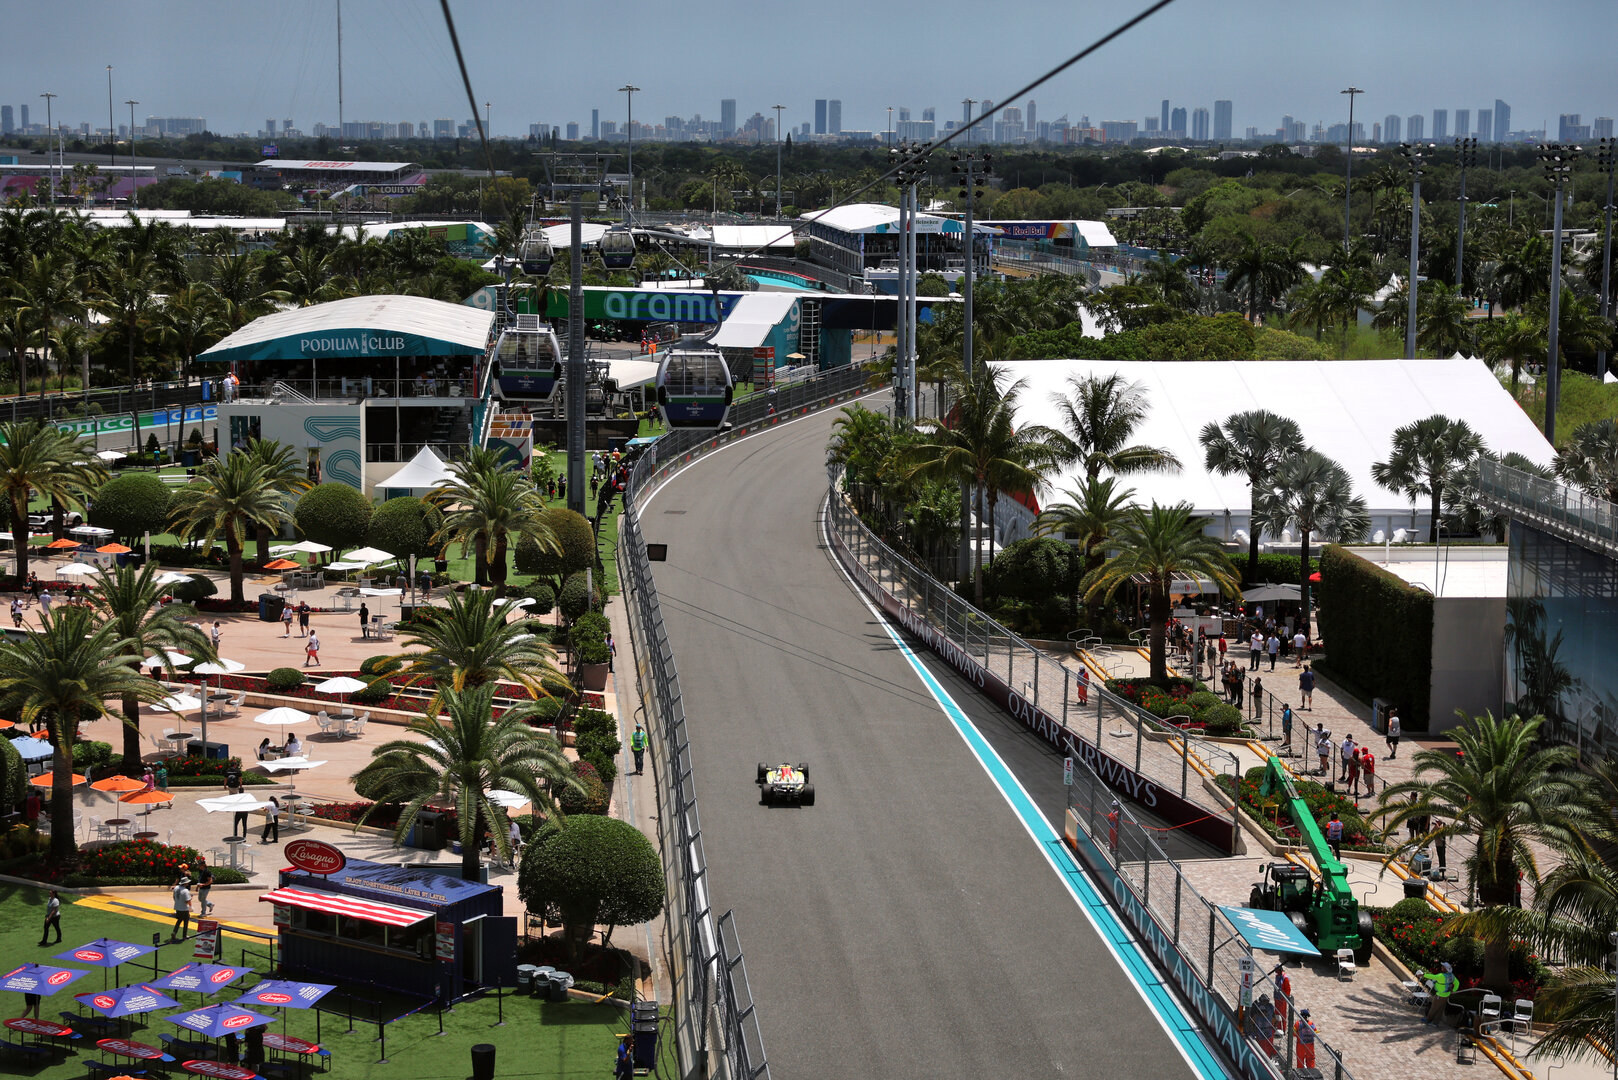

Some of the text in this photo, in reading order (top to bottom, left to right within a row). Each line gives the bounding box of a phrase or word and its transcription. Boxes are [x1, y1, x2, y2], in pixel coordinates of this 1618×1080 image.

[380, 185, 404, 194] LOUIS
[1013, 225, 1046, 235] Red Bull
[789, 300, 801, 332] 9
[300, 336, 405, 352] PODIUM CLUB
[898, 606, 985, 688] QATAR AIRWAYS
[1008, 691, 1158, 808] QATAR AIRWAYS
[291, 846, 336, 866] Lasagna
[1340, 898, 1349, 906] 12
[1113, 876, 1260, 1080] QATAR AIRWAYS
